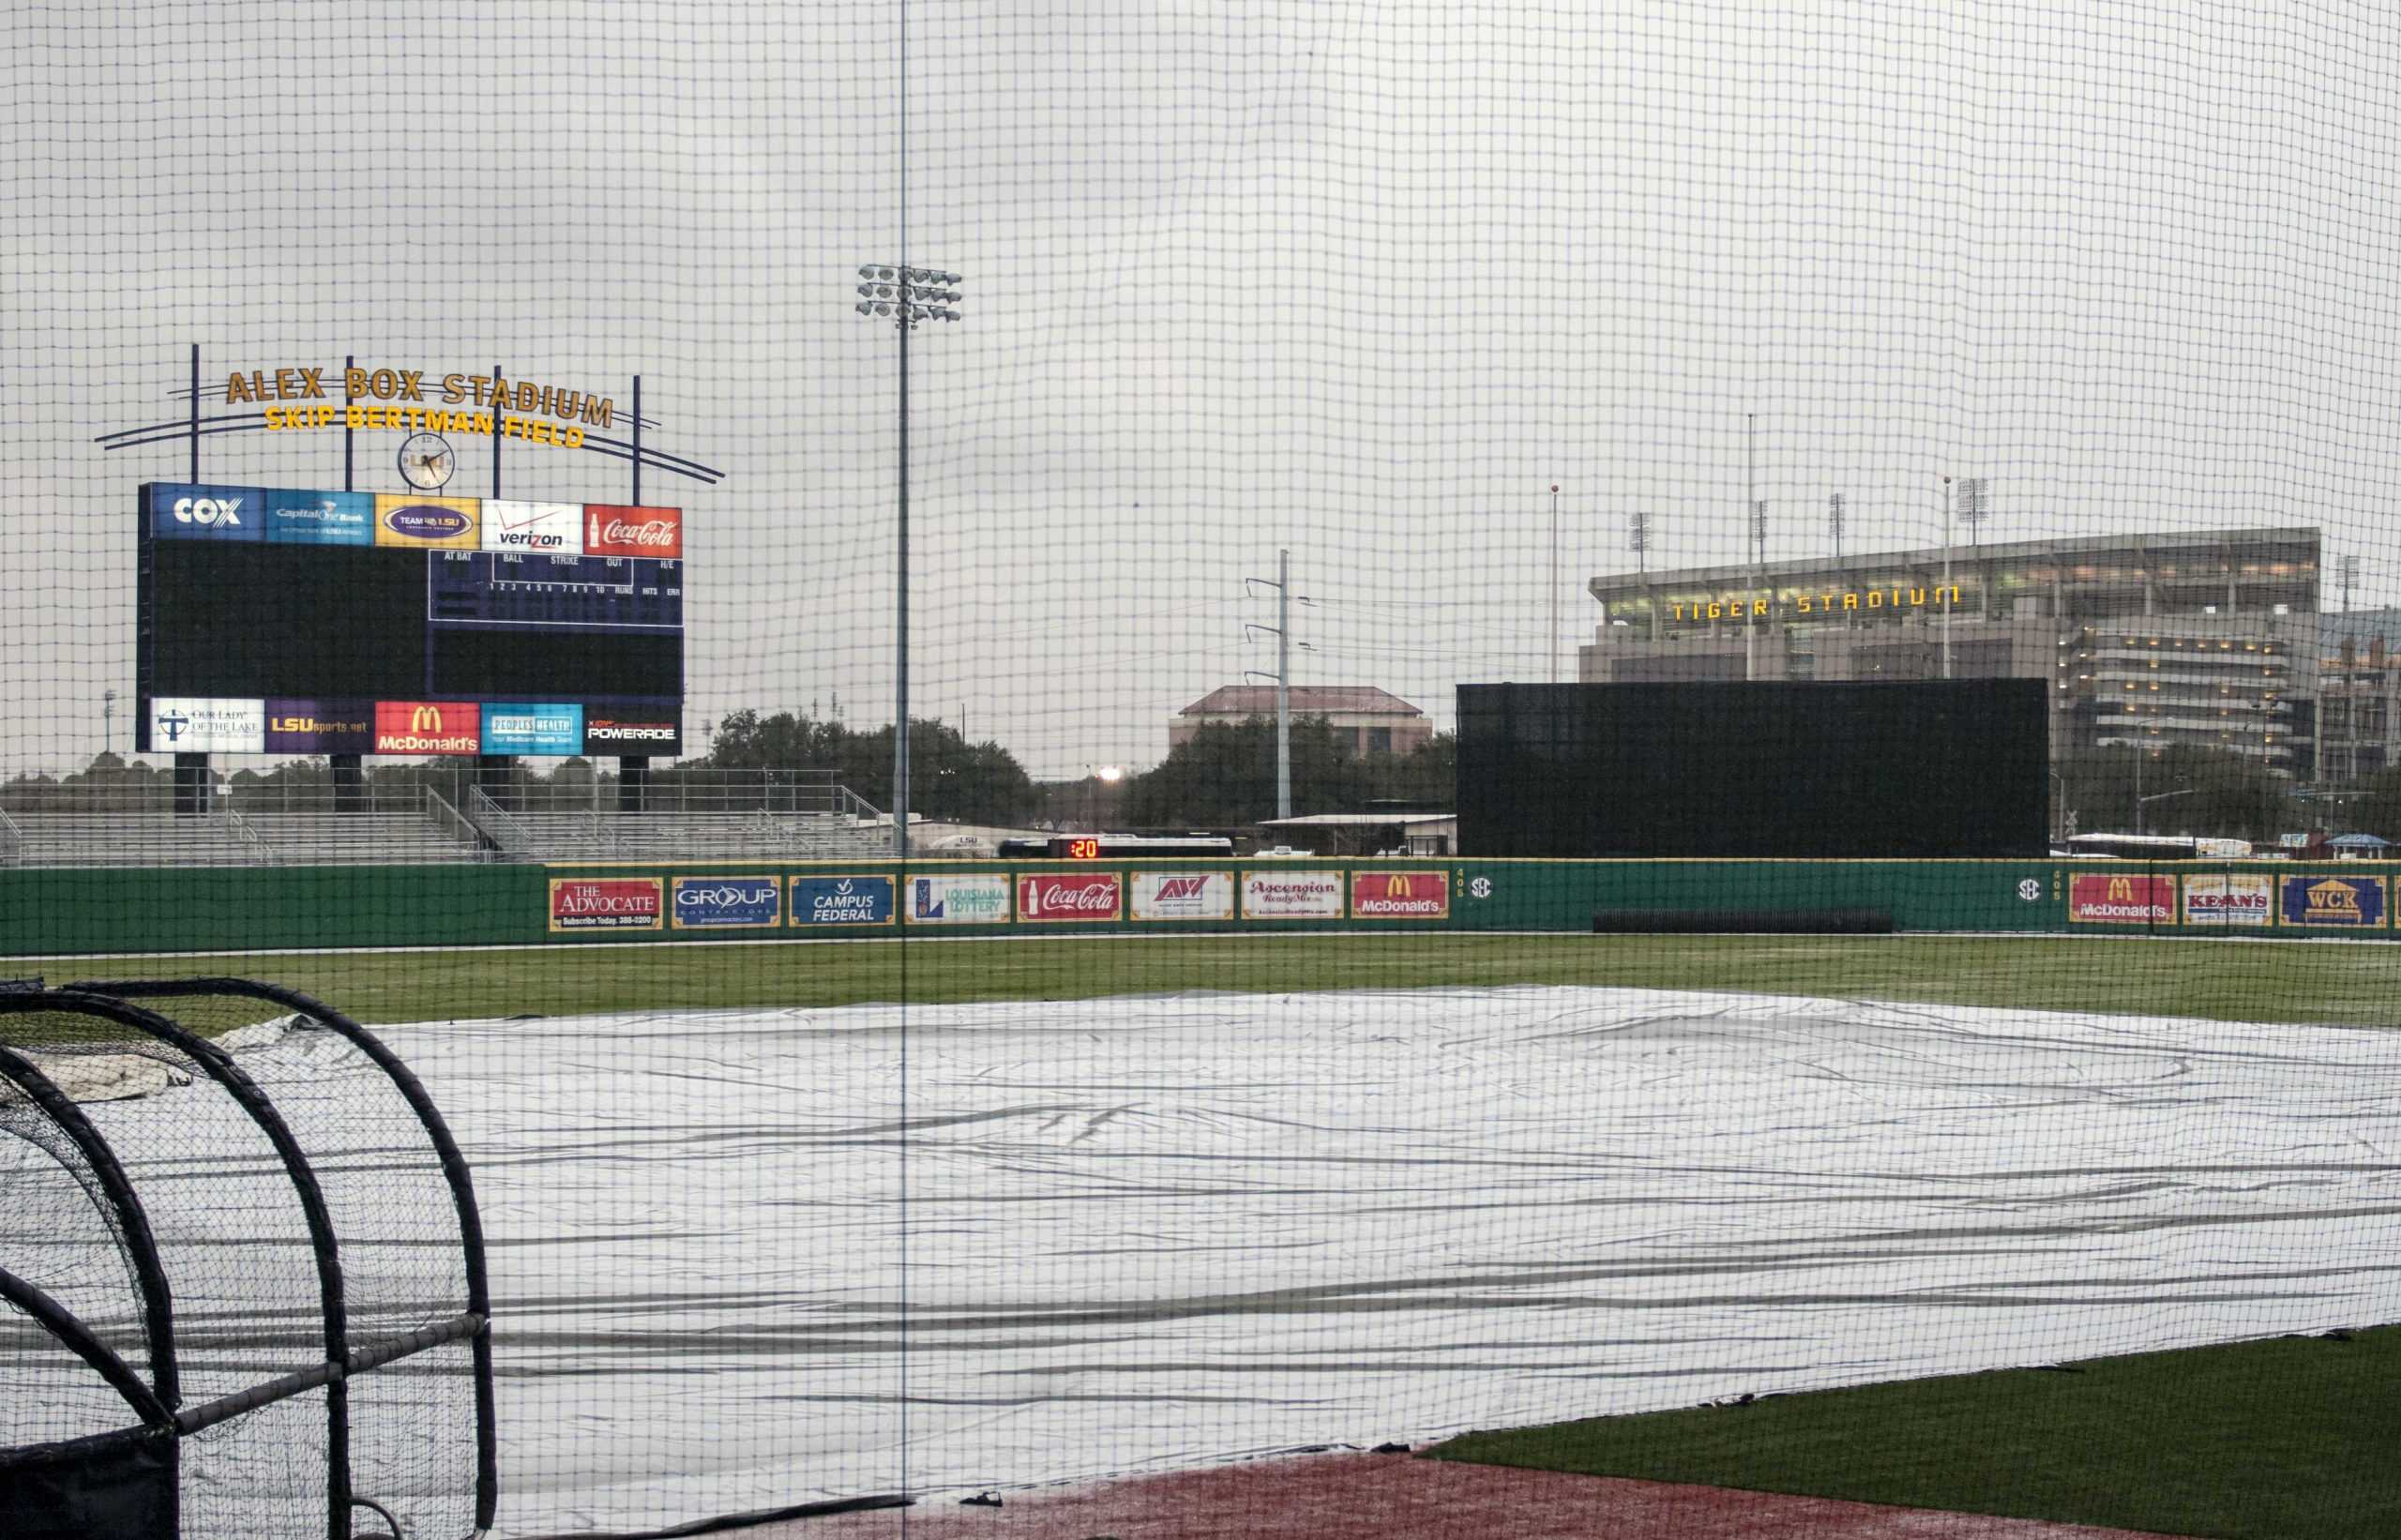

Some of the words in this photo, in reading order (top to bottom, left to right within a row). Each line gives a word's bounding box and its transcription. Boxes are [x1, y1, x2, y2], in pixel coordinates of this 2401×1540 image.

[226, 367, 326, 404] ALEX
[344, 367, 424, 401] BOX
[442, 373, 613, 429] STADIUM
[264, 404, 335, 430] SKIP
[346, 404, 494, 436] BERTMAN
[503, 415, 584, 448] FIELD
[174, 496, 244, 528] COX
[400, 517, 424, 525] TEAM
[438, 518, 460, 526] LSU
[500, 531, 563, 548] verizon
[444, 552, 455, 561] AT
[457, 552, 472, 561] BAT
[503, 553, 523, 563] BALL
[551, 556, 579, 566] STRIKE
[607, 558, 623, 567] OUT
[596, 585, 605, 594] 10
[1673, 598, 1768, 622] TIGER
[1798, 585, 1959, 612] STADIUM
[191, 711, 215, 719] OUR
[219, 711, 246, 719] LADY
[494, 719, 533, 731] PEOPLES
[536, 719, 570, 731] HEALTH
[588, 728, 676, 740] POWERADE
[378, 736, 477, 750] McDonald's
[574, 885, 600, 897] THE
[1249, 881, 1336, 894] Ascension
[1472, 877, 1491, 898] SEC
[2018, 879, 2041, 900] SEC
[677, 885, 777, 909] GROUP
[945, 889, 1004, 900] LOUISIANA
[2188, 893, 2267, 908] KEAN'S
[2307, 892, 2359, 908] WCK
[560, 894, 655, 913] ADVOCATE
[814, 896, 874, 909] CAMPUS
[949, 901, 1000, 913] LOTTERY
[1362, 900, 1440, 912] McDonald's
[813, 909, 874, 922] FEDERAL
[2080, 904, 2167, 917] McDonald's
[564, 916, 596, 925] Subscribe
